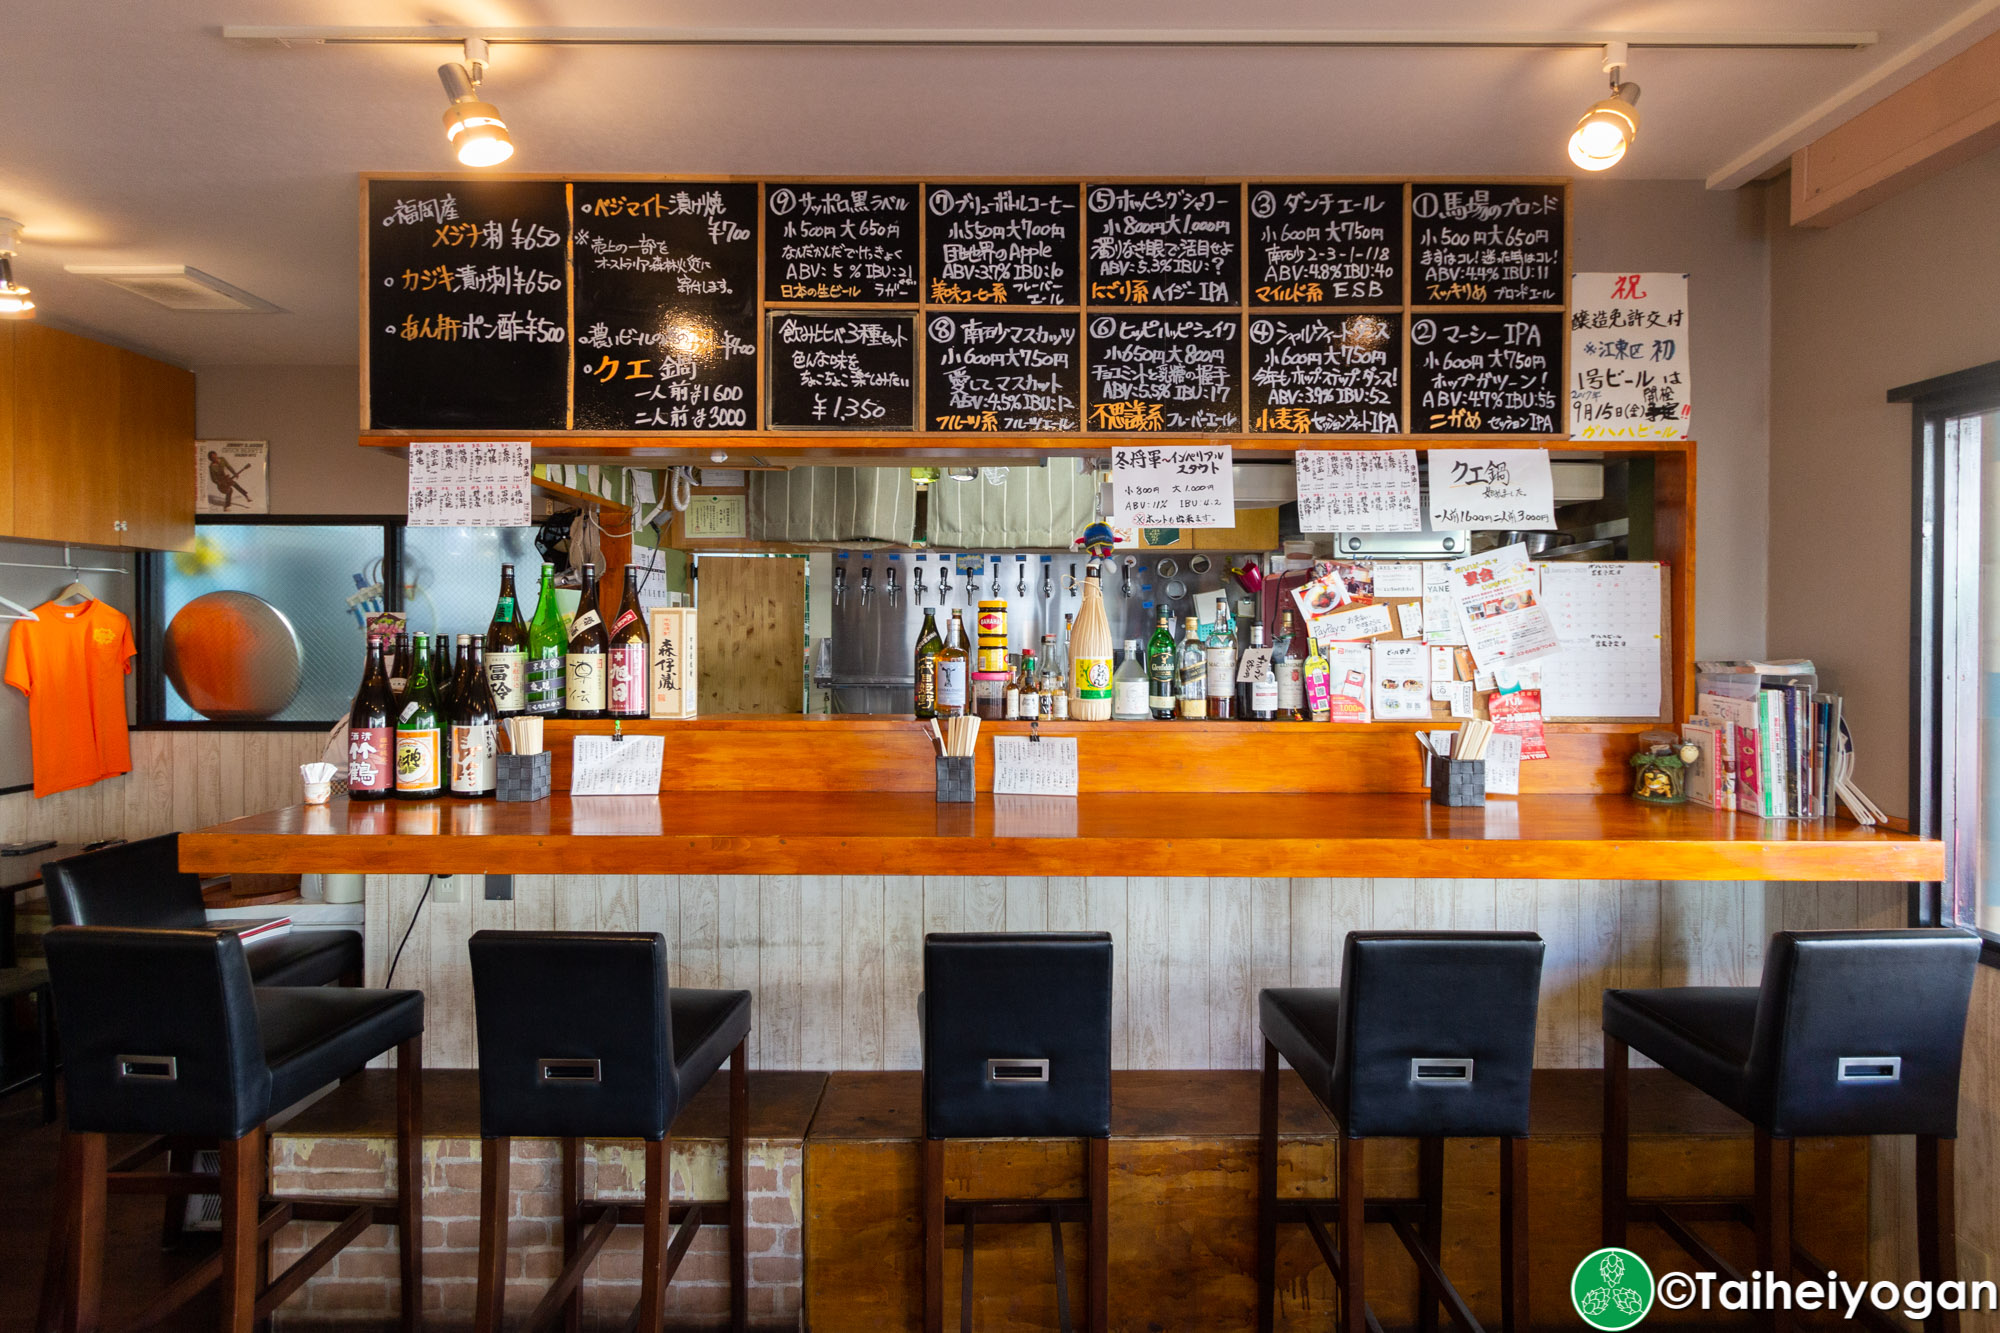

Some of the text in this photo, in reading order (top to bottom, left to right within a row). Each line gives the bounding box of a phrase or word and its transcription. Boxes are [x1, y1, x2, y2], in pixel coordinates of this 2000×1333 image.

[394, 194, 459, 223] 福岡産
[708, 216, 750, 244] ¥700
[781, 283, 861, 298] 日本の生ビール
[1092, 280, 1148, 303] にごり系
[1256, 281, 1383, 302] マイルド系 ESB
[1426, 283, 1555, 302] スッキリめ ブロンドエール
[1611, 274, 1647, 300] 祝
[779, 319, 907, 347] 飲み比べ3種セット
[792, 350, 859, 370] 色んな味を
[800, 369, 909, 387] ちょこちょこ楽しみたい
[936, 411, 998, 431] フルーツ系
[1090, 400, 1164, 431] 不思議系
[1256, 407, 1311, 433] 小麦系
[1430, 408, 1481, 430] ニガめ
[1582, 424, 1678, 439] ガハハビール
[1177, 462, 1219, 474] スタウト
[1451, 460, 1510, 486] クエ鍋
[654, 639, 681, 691] 森伊蔵
[349, 742, 378, 786] 竹鶴
